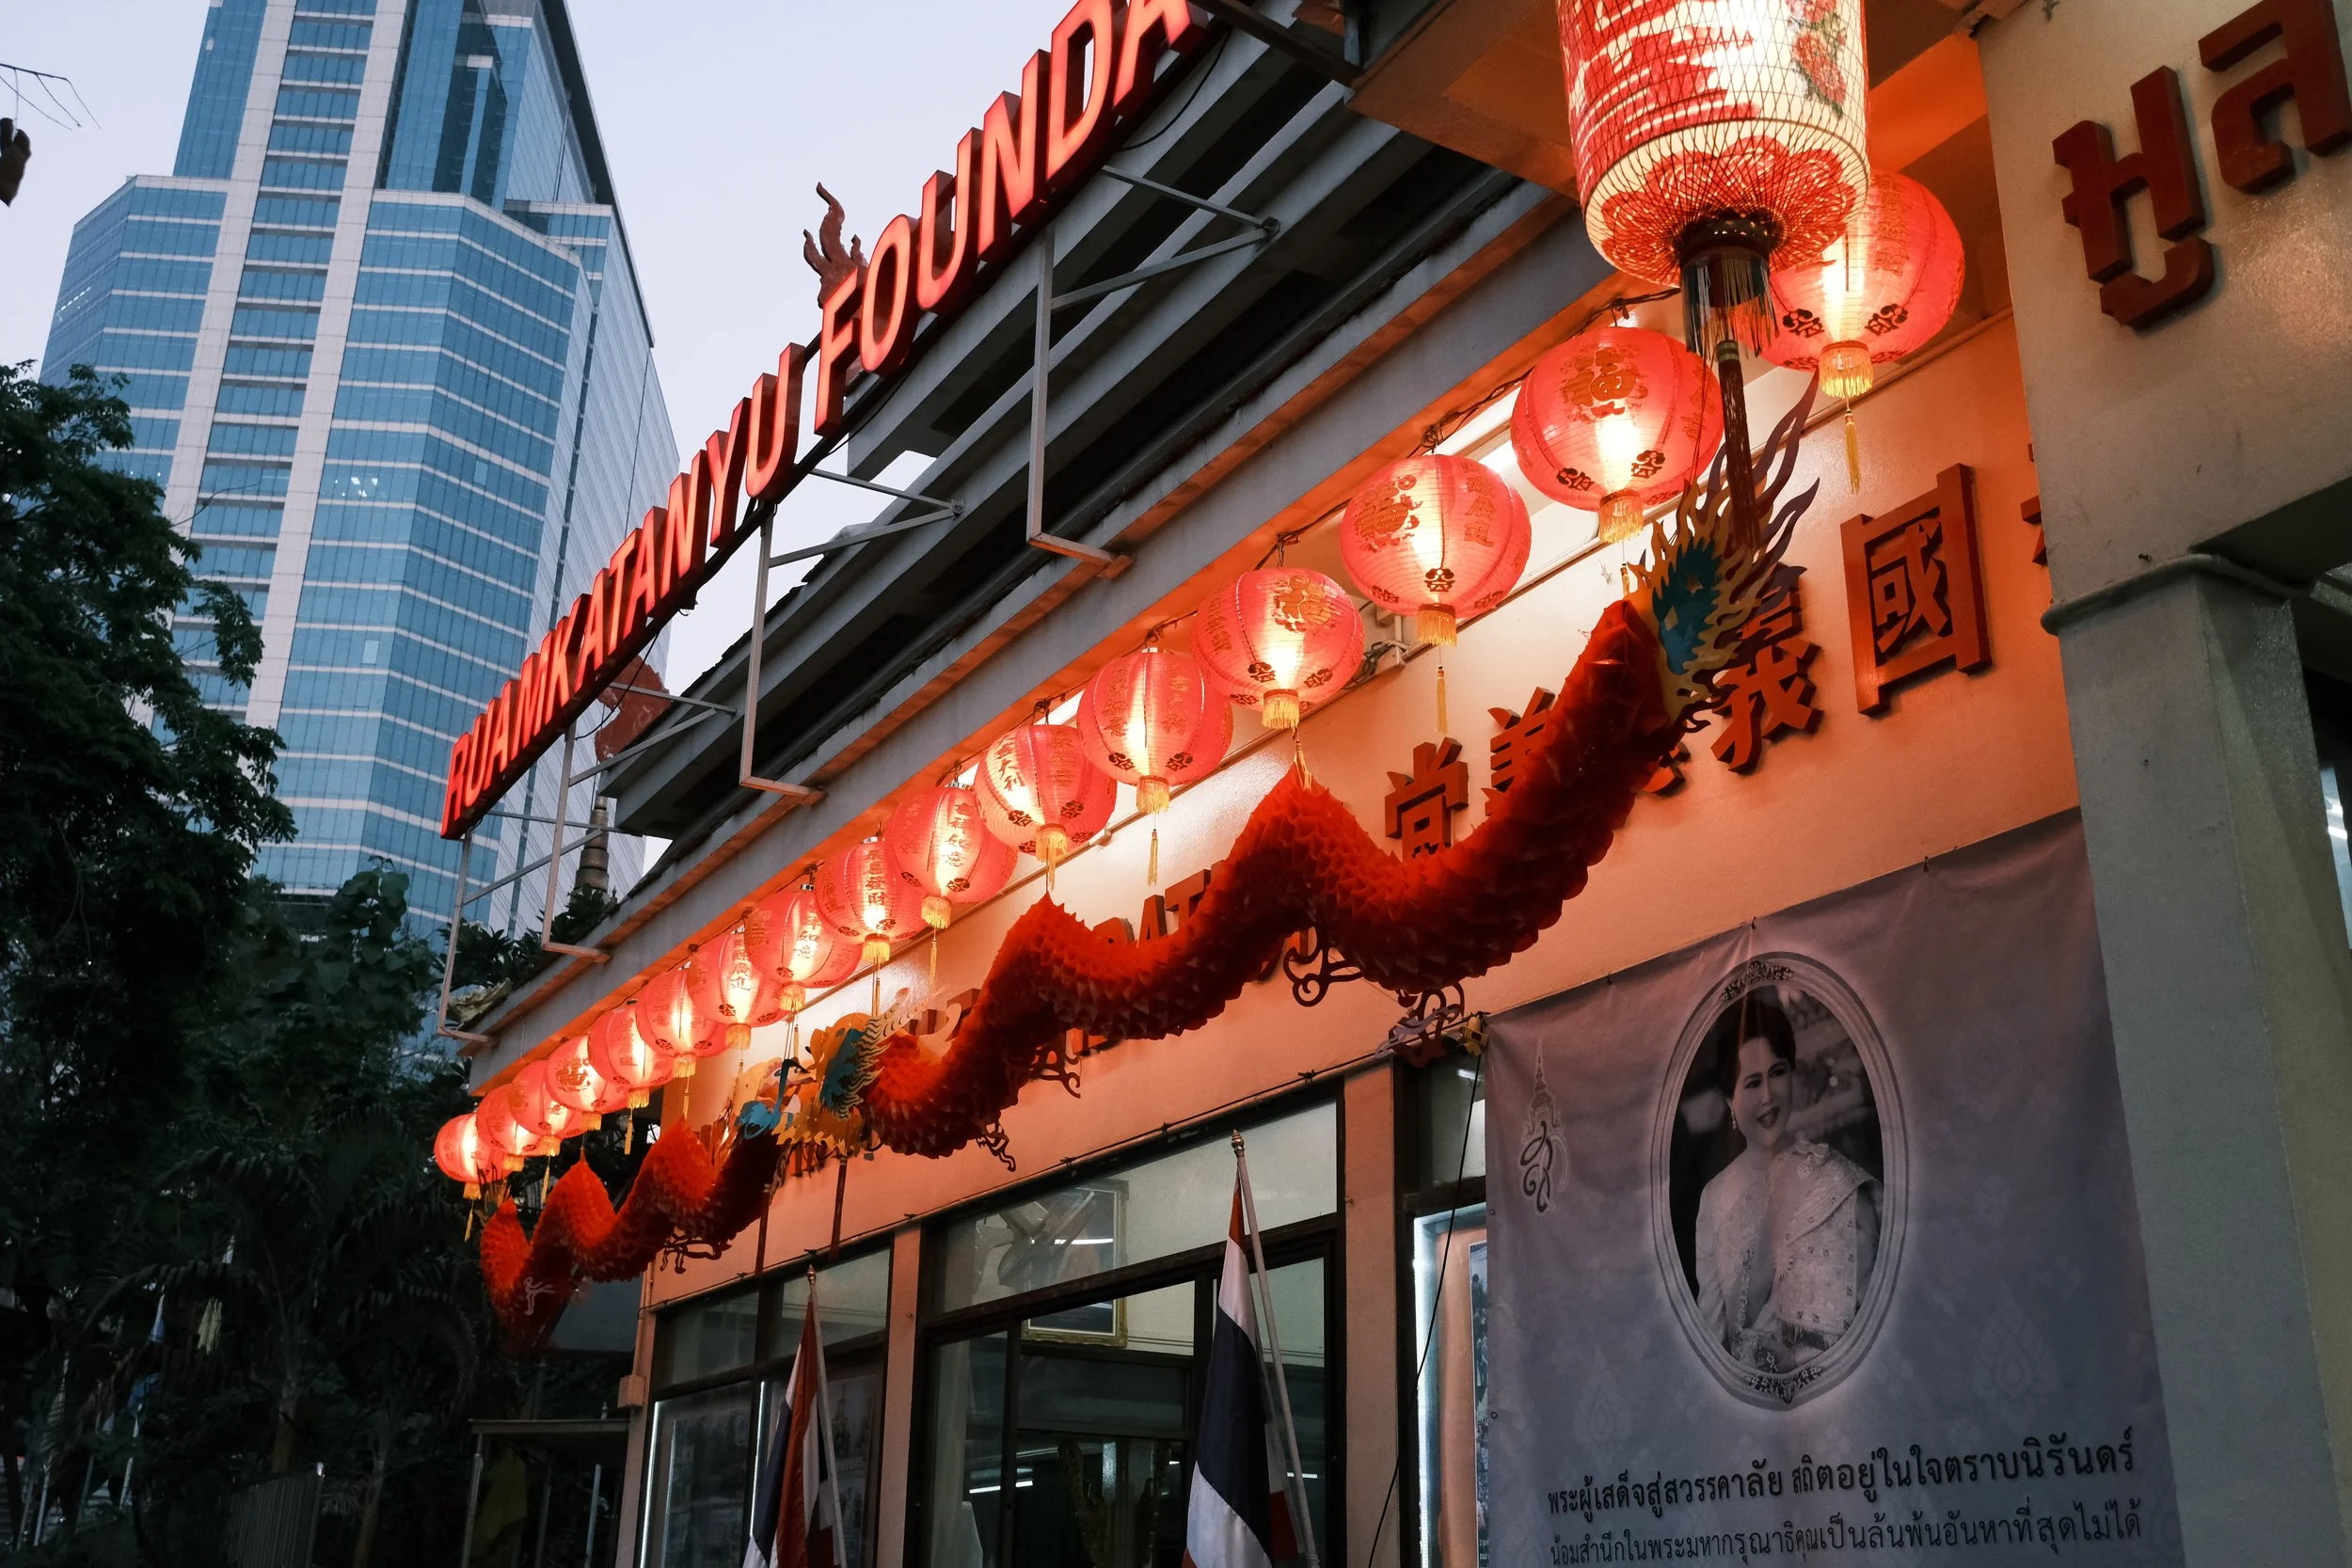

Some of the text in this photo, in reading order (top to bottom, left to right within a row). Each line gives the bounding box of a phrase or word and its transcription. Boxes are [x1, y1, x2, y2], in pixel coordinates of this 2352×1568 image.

[440, 341, 806, 839] RUAMKATANYU
[1547, 1424, 2134, 1523] พระผู้เสด็จสู่สวรรคาลัย สถิตอยู่ในใจตราบนิรันดร์
